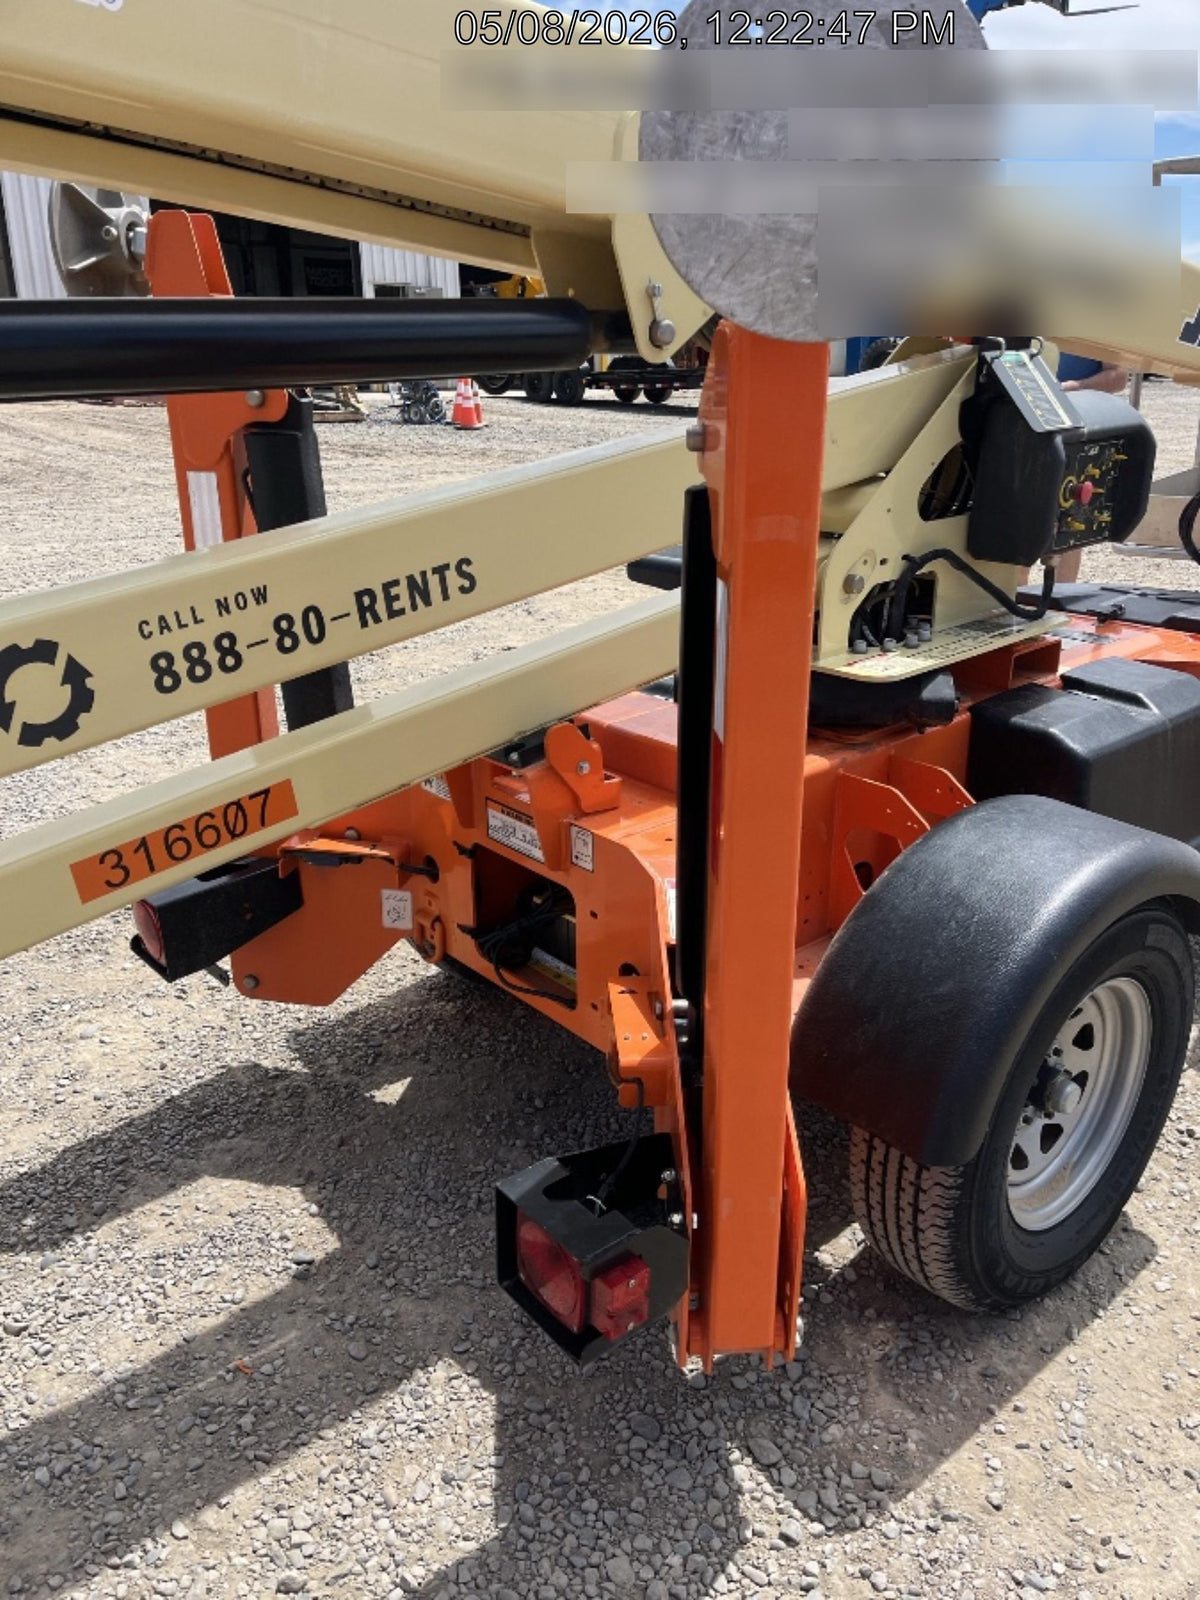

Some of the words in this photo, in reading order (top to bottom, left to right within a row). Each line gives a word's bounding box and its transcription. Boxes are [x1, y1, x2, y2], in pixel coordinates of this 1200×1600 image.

[137, 605, 205, 641] CALL
[214, 584, 269, 618] NOW
[149, 557, 477, 695] 888-80-RENTS
[98, 787, 271, 890] 316607
